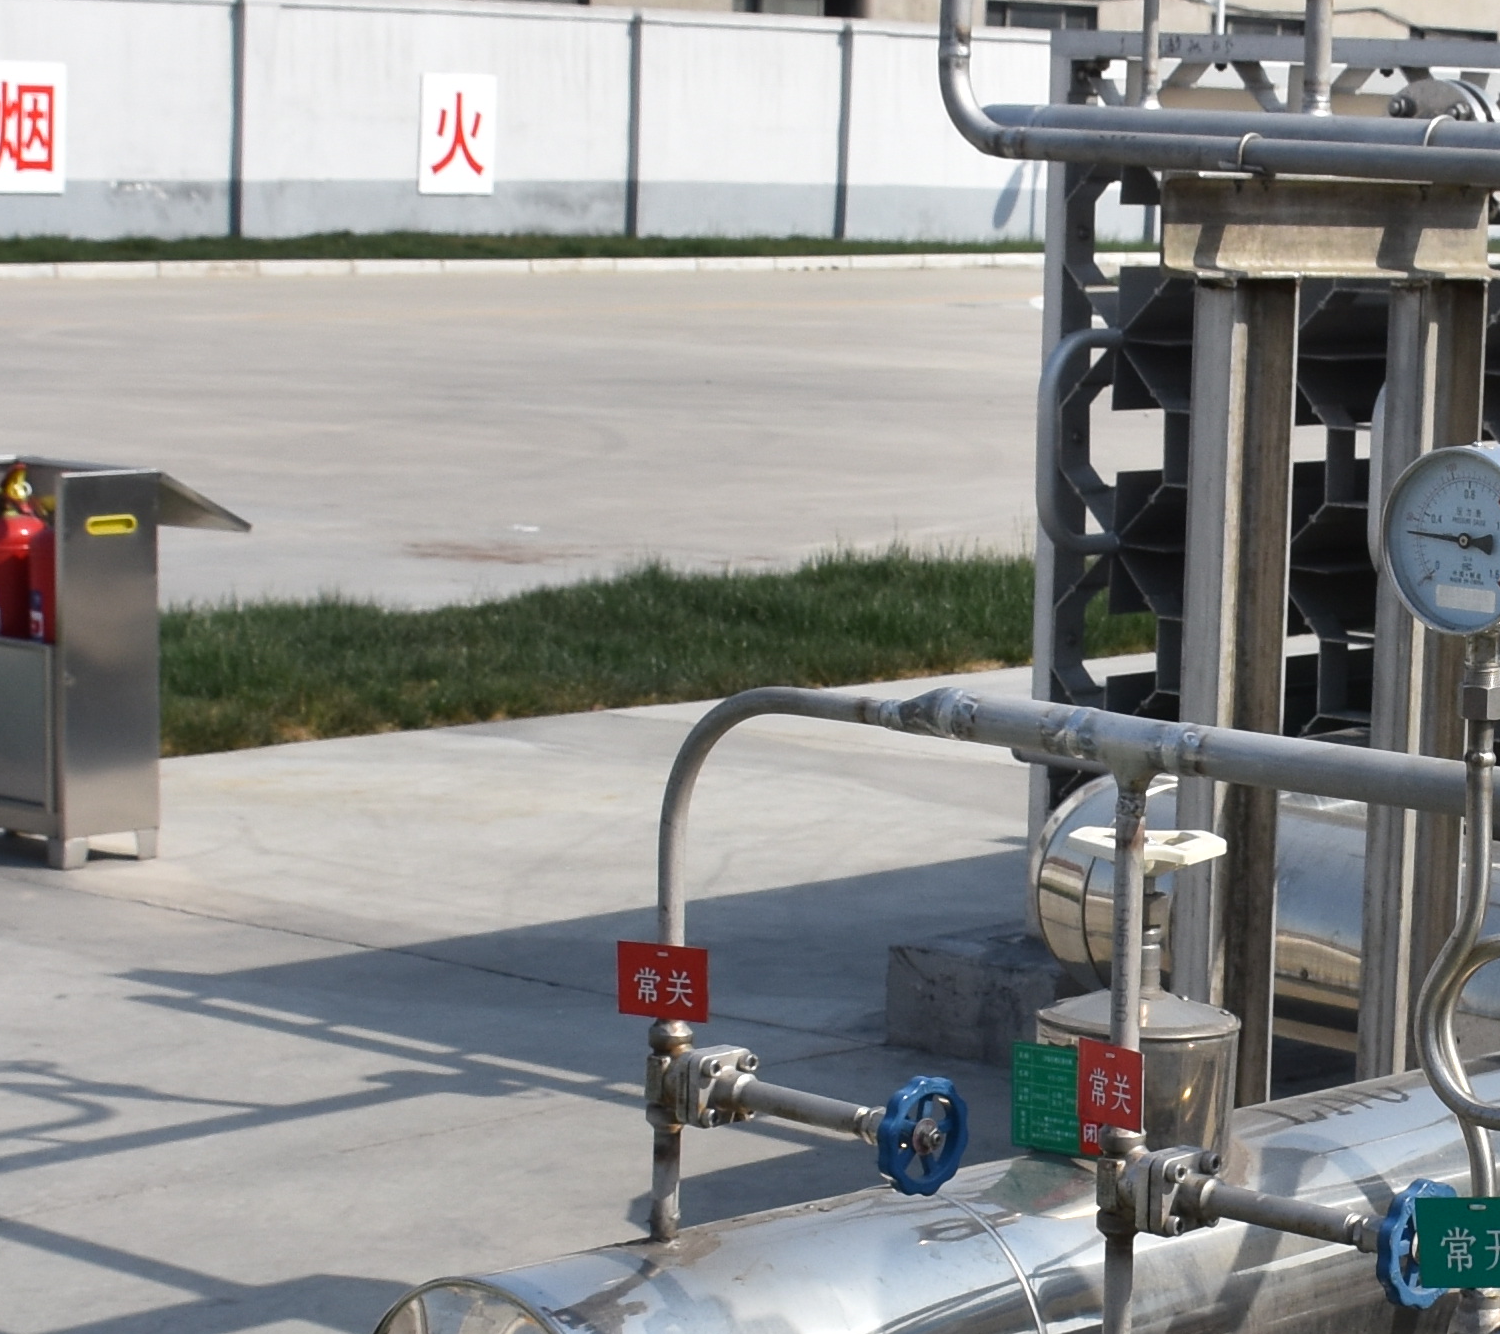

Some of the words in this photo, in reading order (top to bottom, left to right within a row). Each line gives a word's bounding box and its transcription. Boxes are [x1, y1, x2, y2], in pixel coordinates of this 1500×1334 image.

[430, 91, 485, 176] 火
[633, 967, 694, 1009] 常关
[1088, 1067, 1132, 1115] 常关
[1083, 1123, 1098, 1144] 闭
